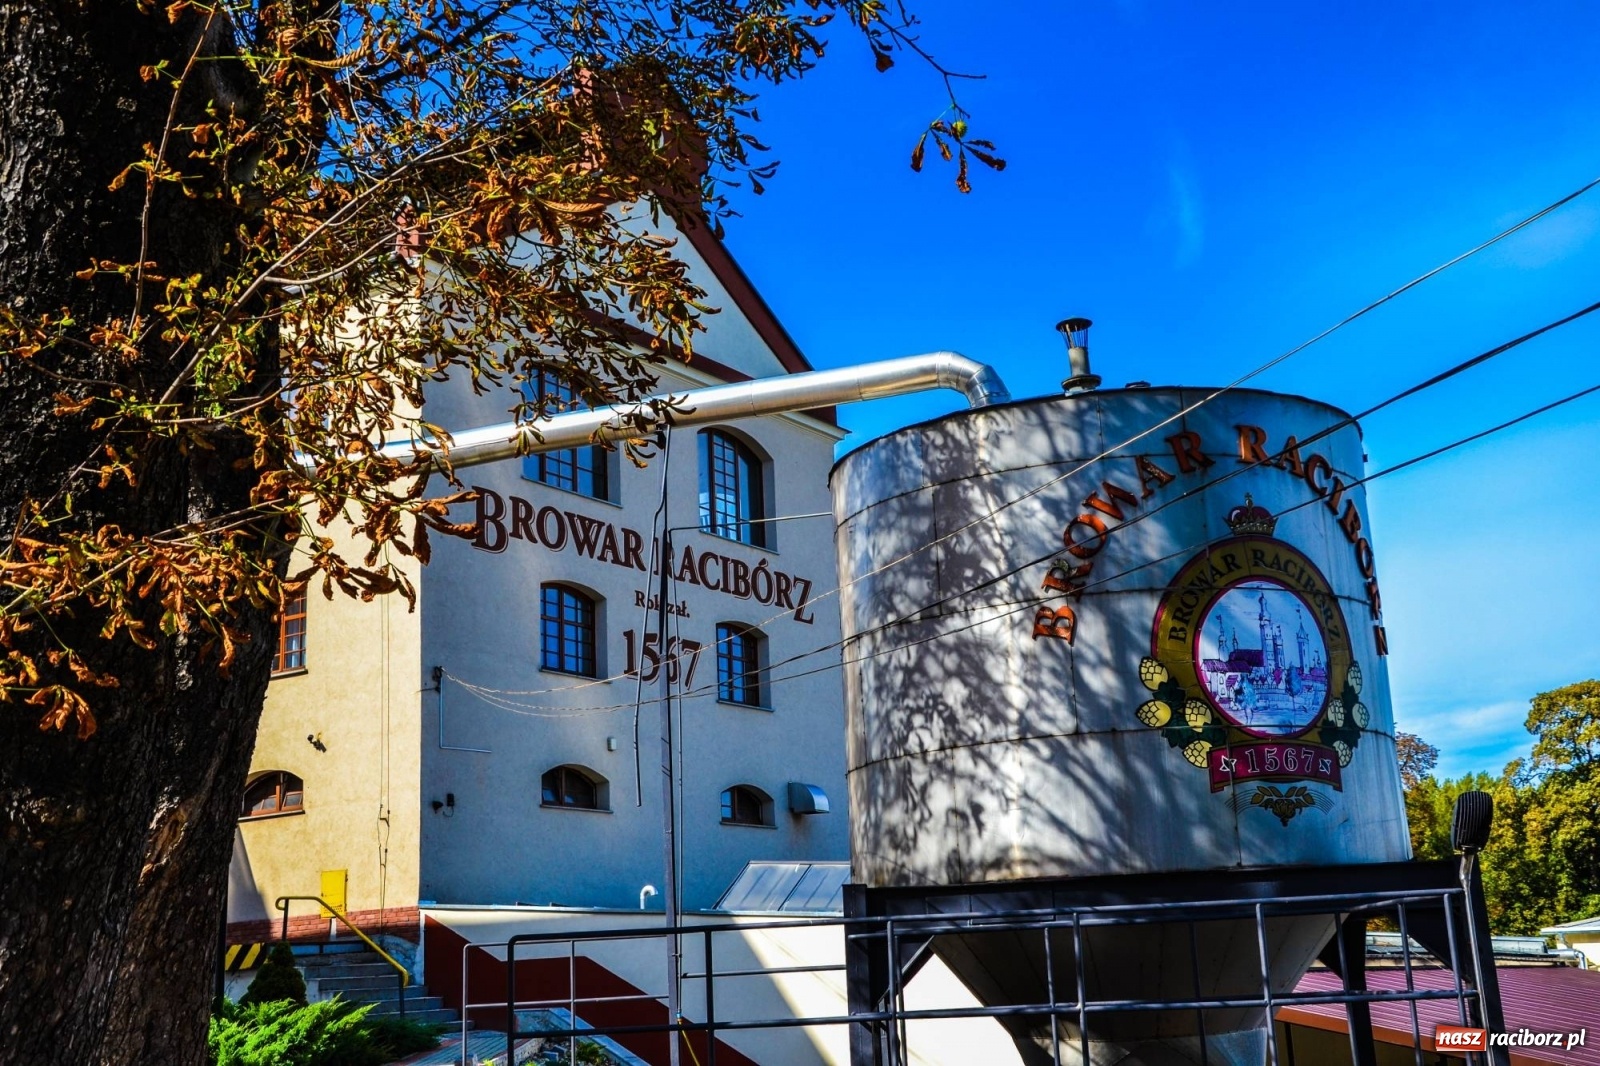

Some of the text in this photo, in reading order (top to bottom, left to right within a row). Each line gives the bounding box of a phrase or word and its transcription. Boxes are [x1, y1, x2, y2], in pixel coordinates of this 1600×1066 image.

[471, 485, 647, 572] BROWAR
[1032, 430, 1215, 647] BROWAR
[1168, 551, 1242, 644] BROWAR
[623, 629, 702, 690] 1567
[1245, 748, 1315, 773] 1567
